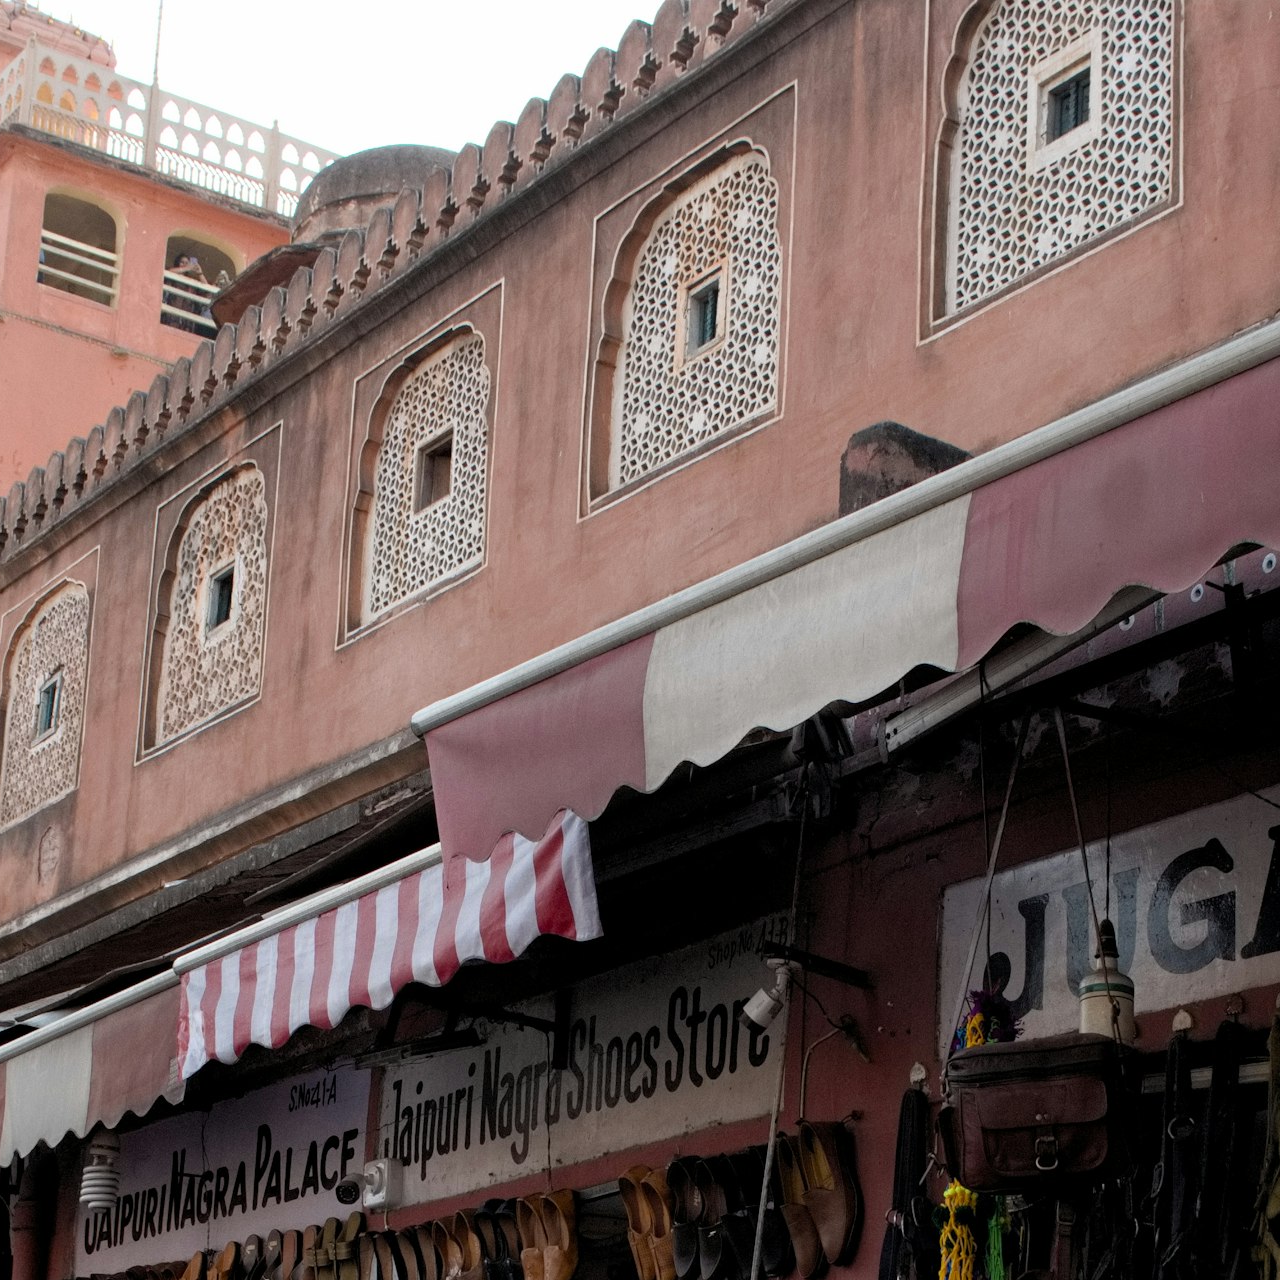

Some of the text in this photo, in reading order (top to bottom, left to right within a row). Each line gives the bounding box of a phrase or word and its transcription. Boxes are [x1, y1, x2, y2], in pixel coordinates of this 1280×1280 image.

[708, 940, 737, 969] Shop
[385, 1062, 476, 1181] Jaipuri
[480, 1046, 563, 1164] Nagra
[566, 1015, 661, 1120] Shoes
[166, 1148, 247, 1232] NAGRA
